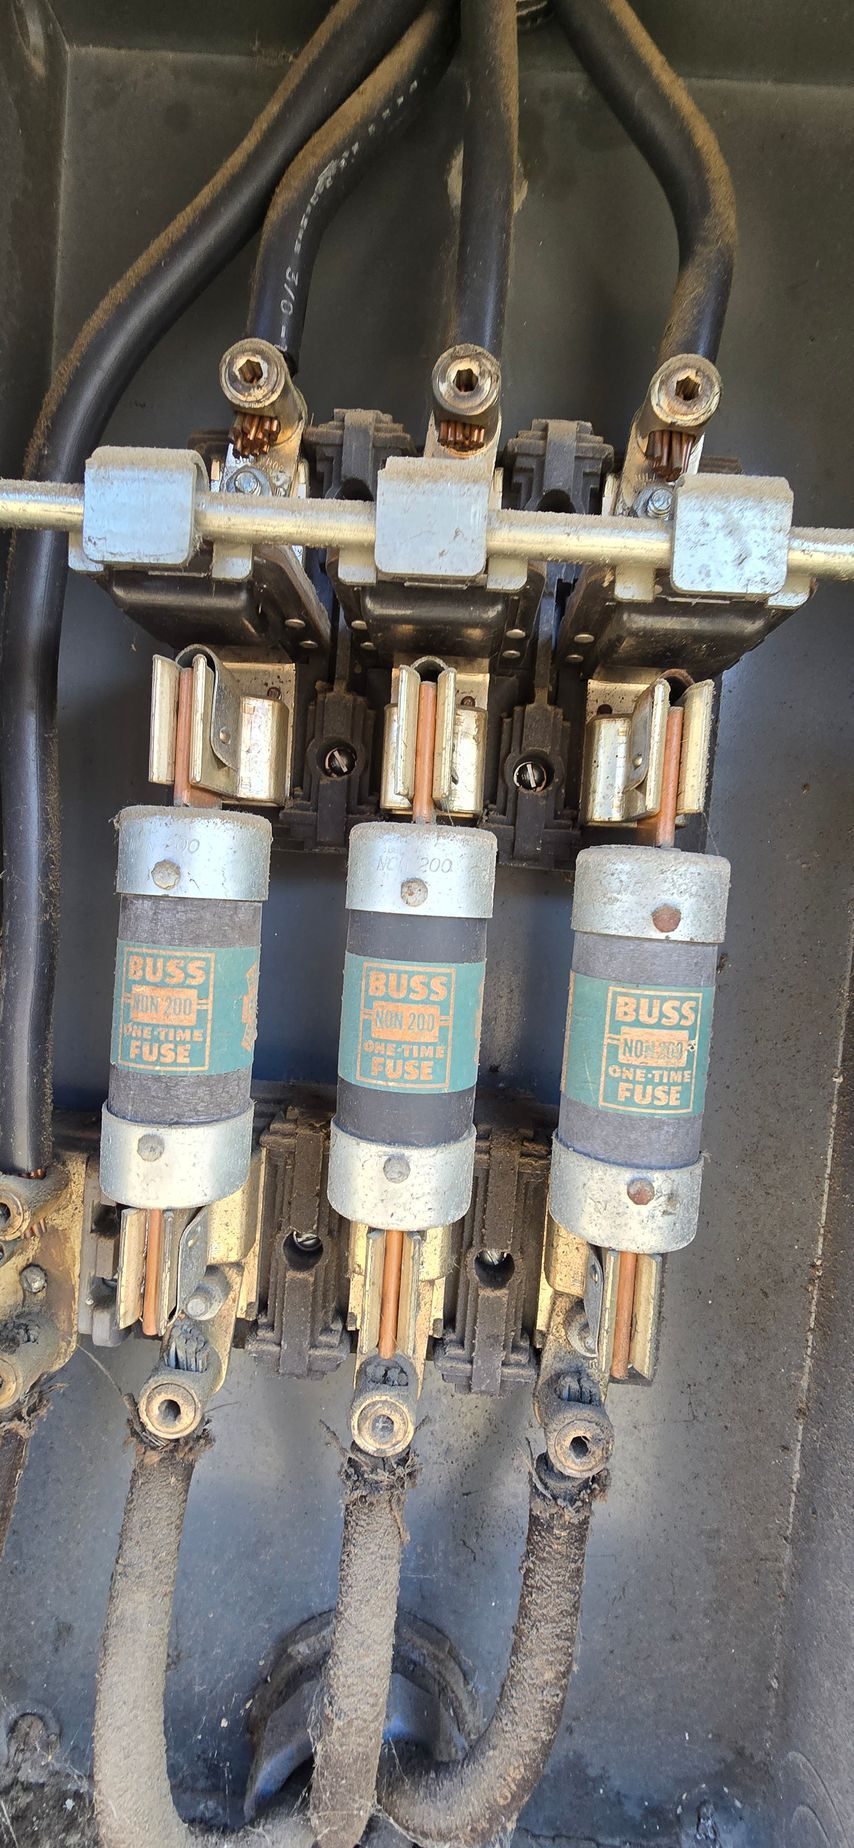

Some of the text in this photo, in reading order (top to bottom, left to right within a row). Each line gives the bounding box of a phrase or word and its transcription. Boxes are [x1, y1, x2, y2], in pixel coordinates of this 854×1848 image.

[280, 265, 299, 316] 3/0
[417, 857, 454, 874] 200
[128, 954, 207, 986] BUSS
[368, 970, 449, 1001] BUSS
[162, 997, 193, 1016] 200
[615, 995, 697, 1027] BUSS
[374, 1008, 436, 1033] NON 200
[129, 1039, 191, 1065] FUSE
[363, 1039, 447, 1059] ONE-TIME
[370, 1056, 434, 1082] FUSE
[608, 1064, 693, 1083] ONE-TIME
[618, 1081, 683, 1107] FUSE
